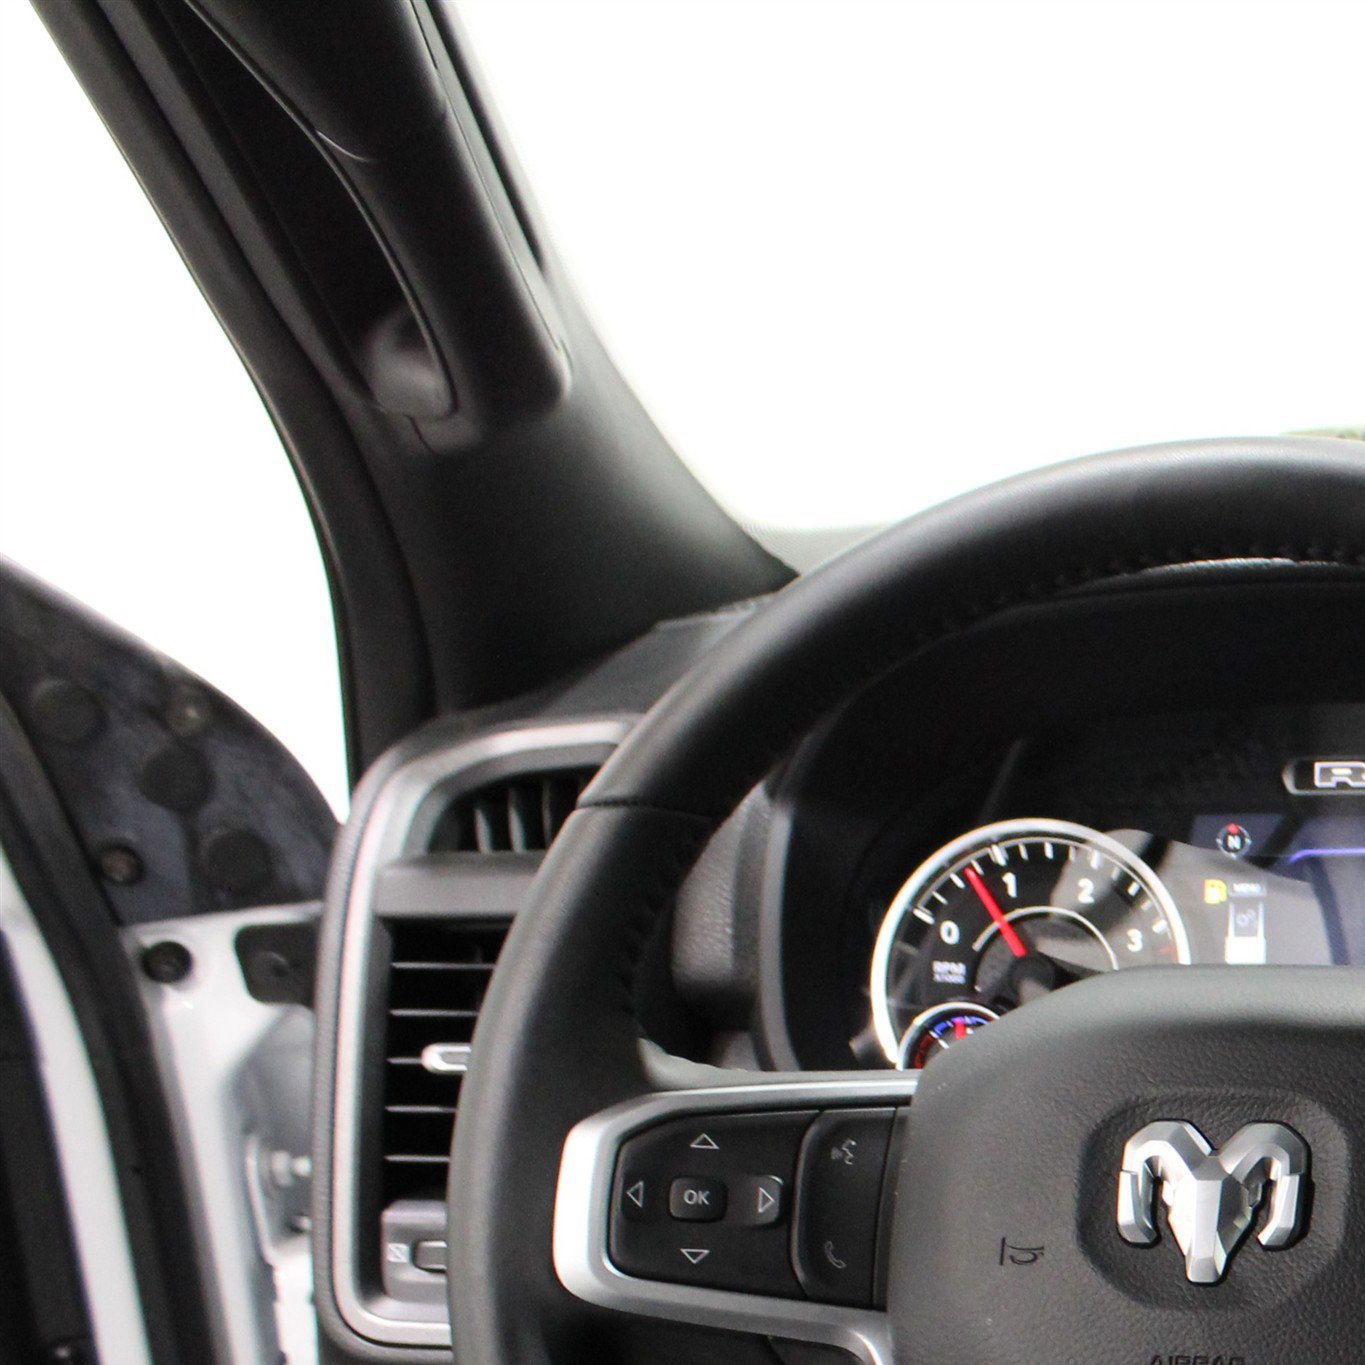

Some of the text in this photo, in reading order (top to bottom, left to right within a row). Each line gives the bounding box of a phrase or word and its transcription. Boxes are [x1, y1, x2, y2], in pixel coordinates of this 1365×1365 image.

[1002, 872, 1017, 898] 1
[1078, 878, 1095, 904] 2
[939, 920, 960, 945] 0
[1126, 928, 1144, 952] 3
[682, 1190, 711, 1206] OK
